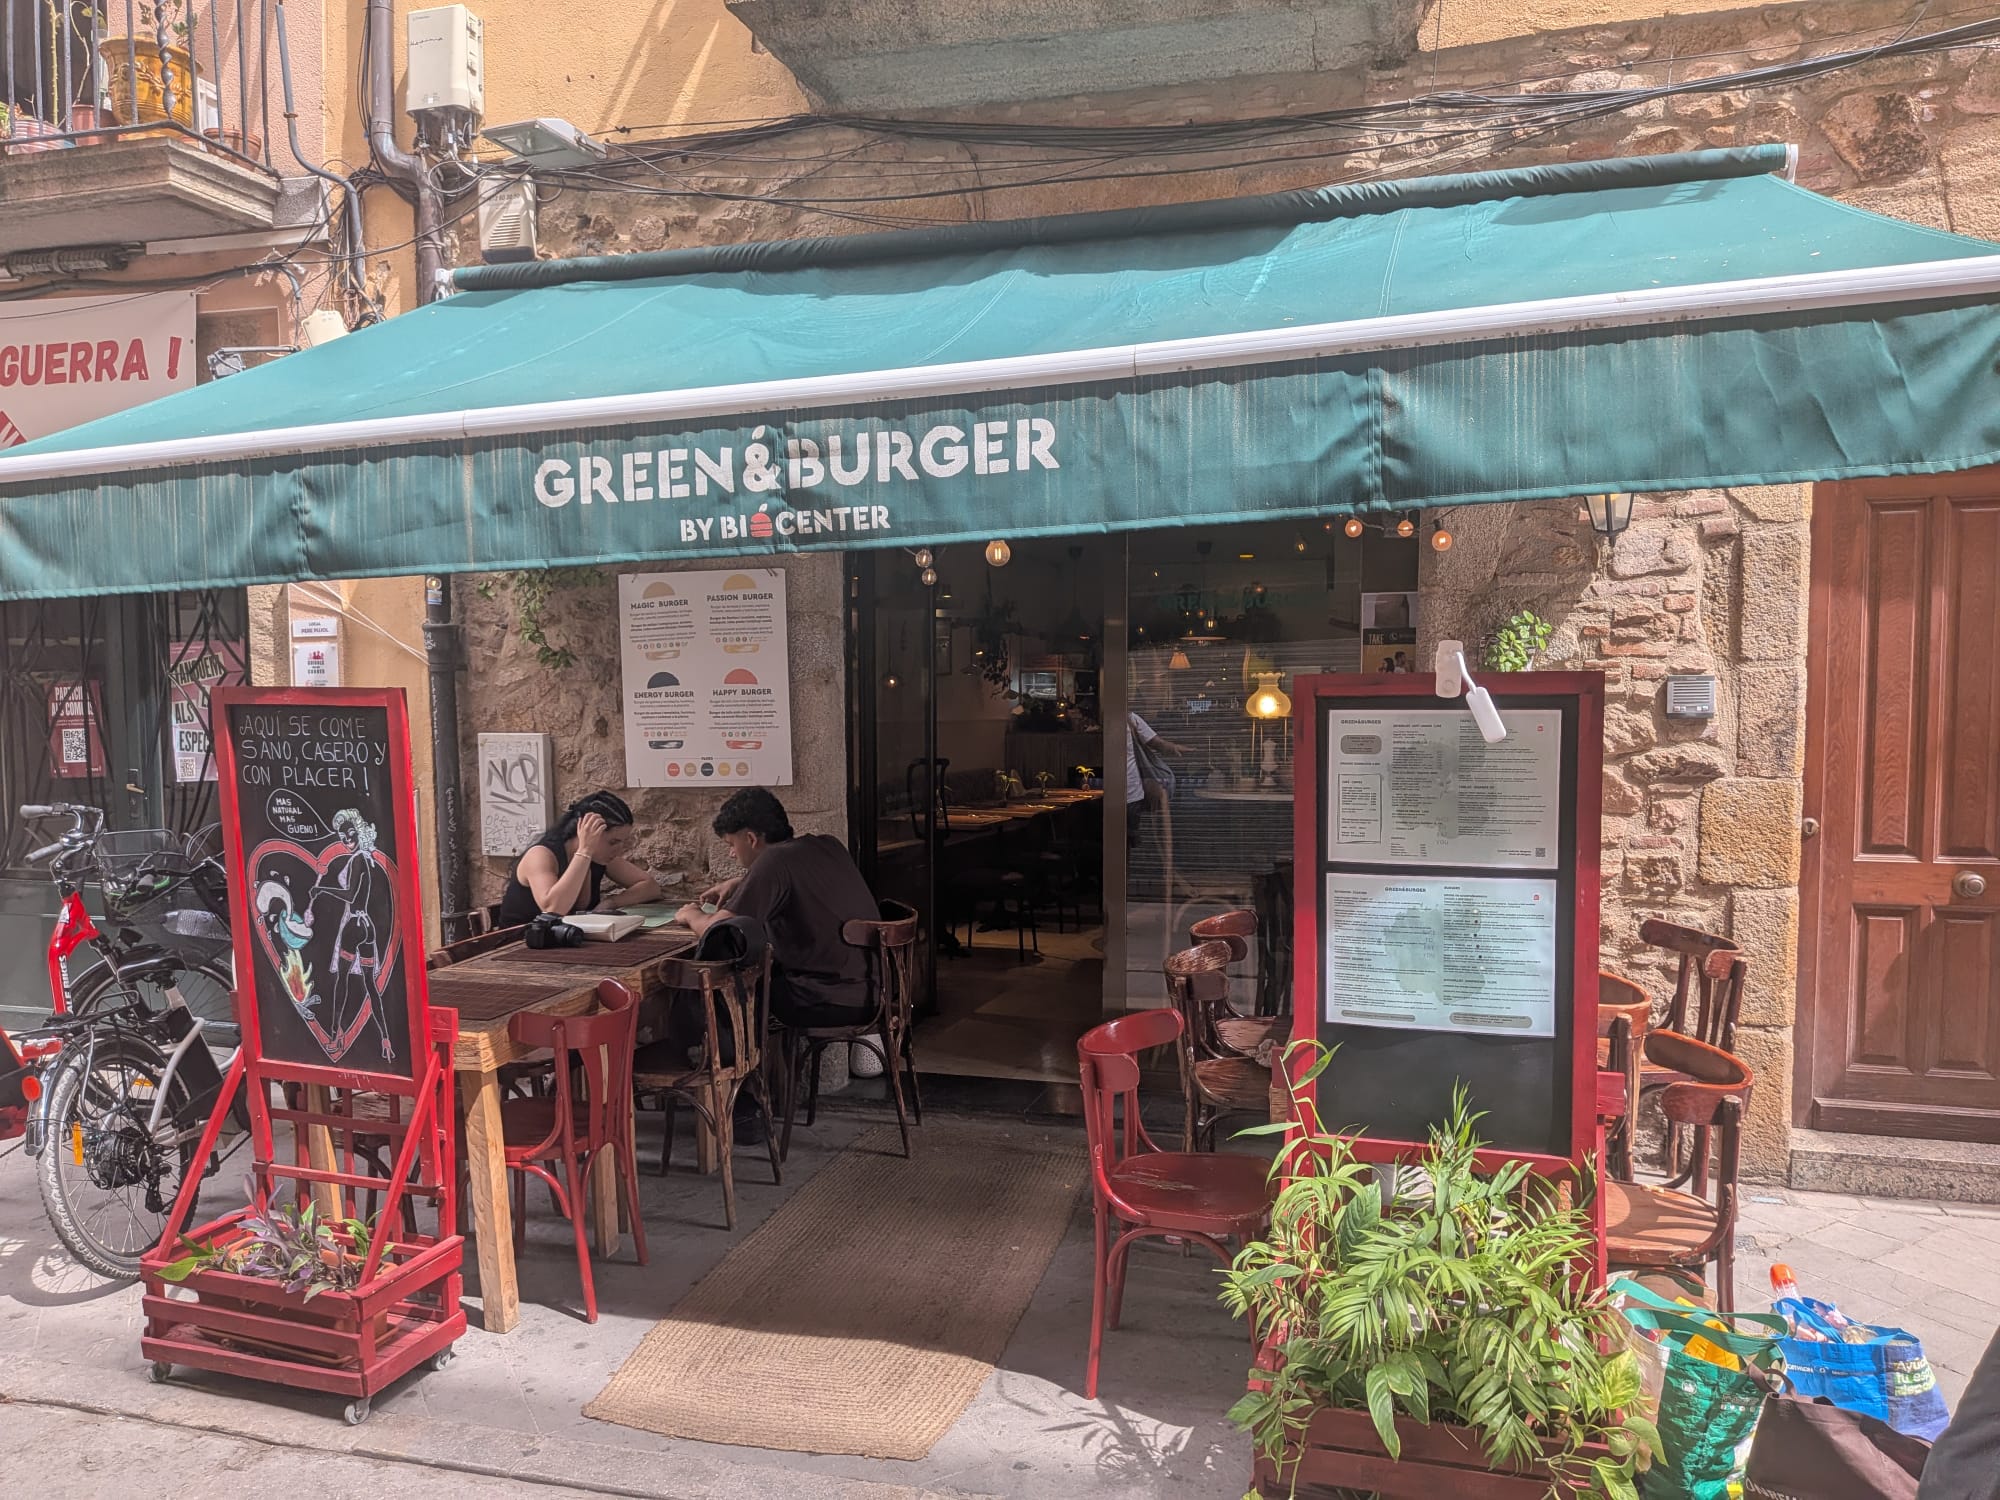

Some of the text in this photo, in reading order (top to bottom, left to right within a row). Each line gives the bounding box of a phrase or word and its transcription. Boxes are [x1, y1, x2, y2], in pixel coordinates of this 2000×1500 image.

[0, 338, 149, 387] GUERRA
[680, 517, 714, 542] BY
[706, 592, 774, 602] PASSION BURGER
[630, 599, 689, 609] MAGIC BURGER
[634, 690, 695, 699] ENERGY BURGER
[741, 688, 772, 696] BURGER
[175, 701, 195, 724] ALS
[288, 715, 311, 736] SE
[319, 716, 366, 739] COME
[242, 764, 271, 786] CON
[283, 765, 356, 789] PLACER
[275, 797, 292, 806] MAS
[272, 806, 303, 815] NATURAL
[279, 815, 296, 823] MAS
[59, 954, 71, 989] BIKES
